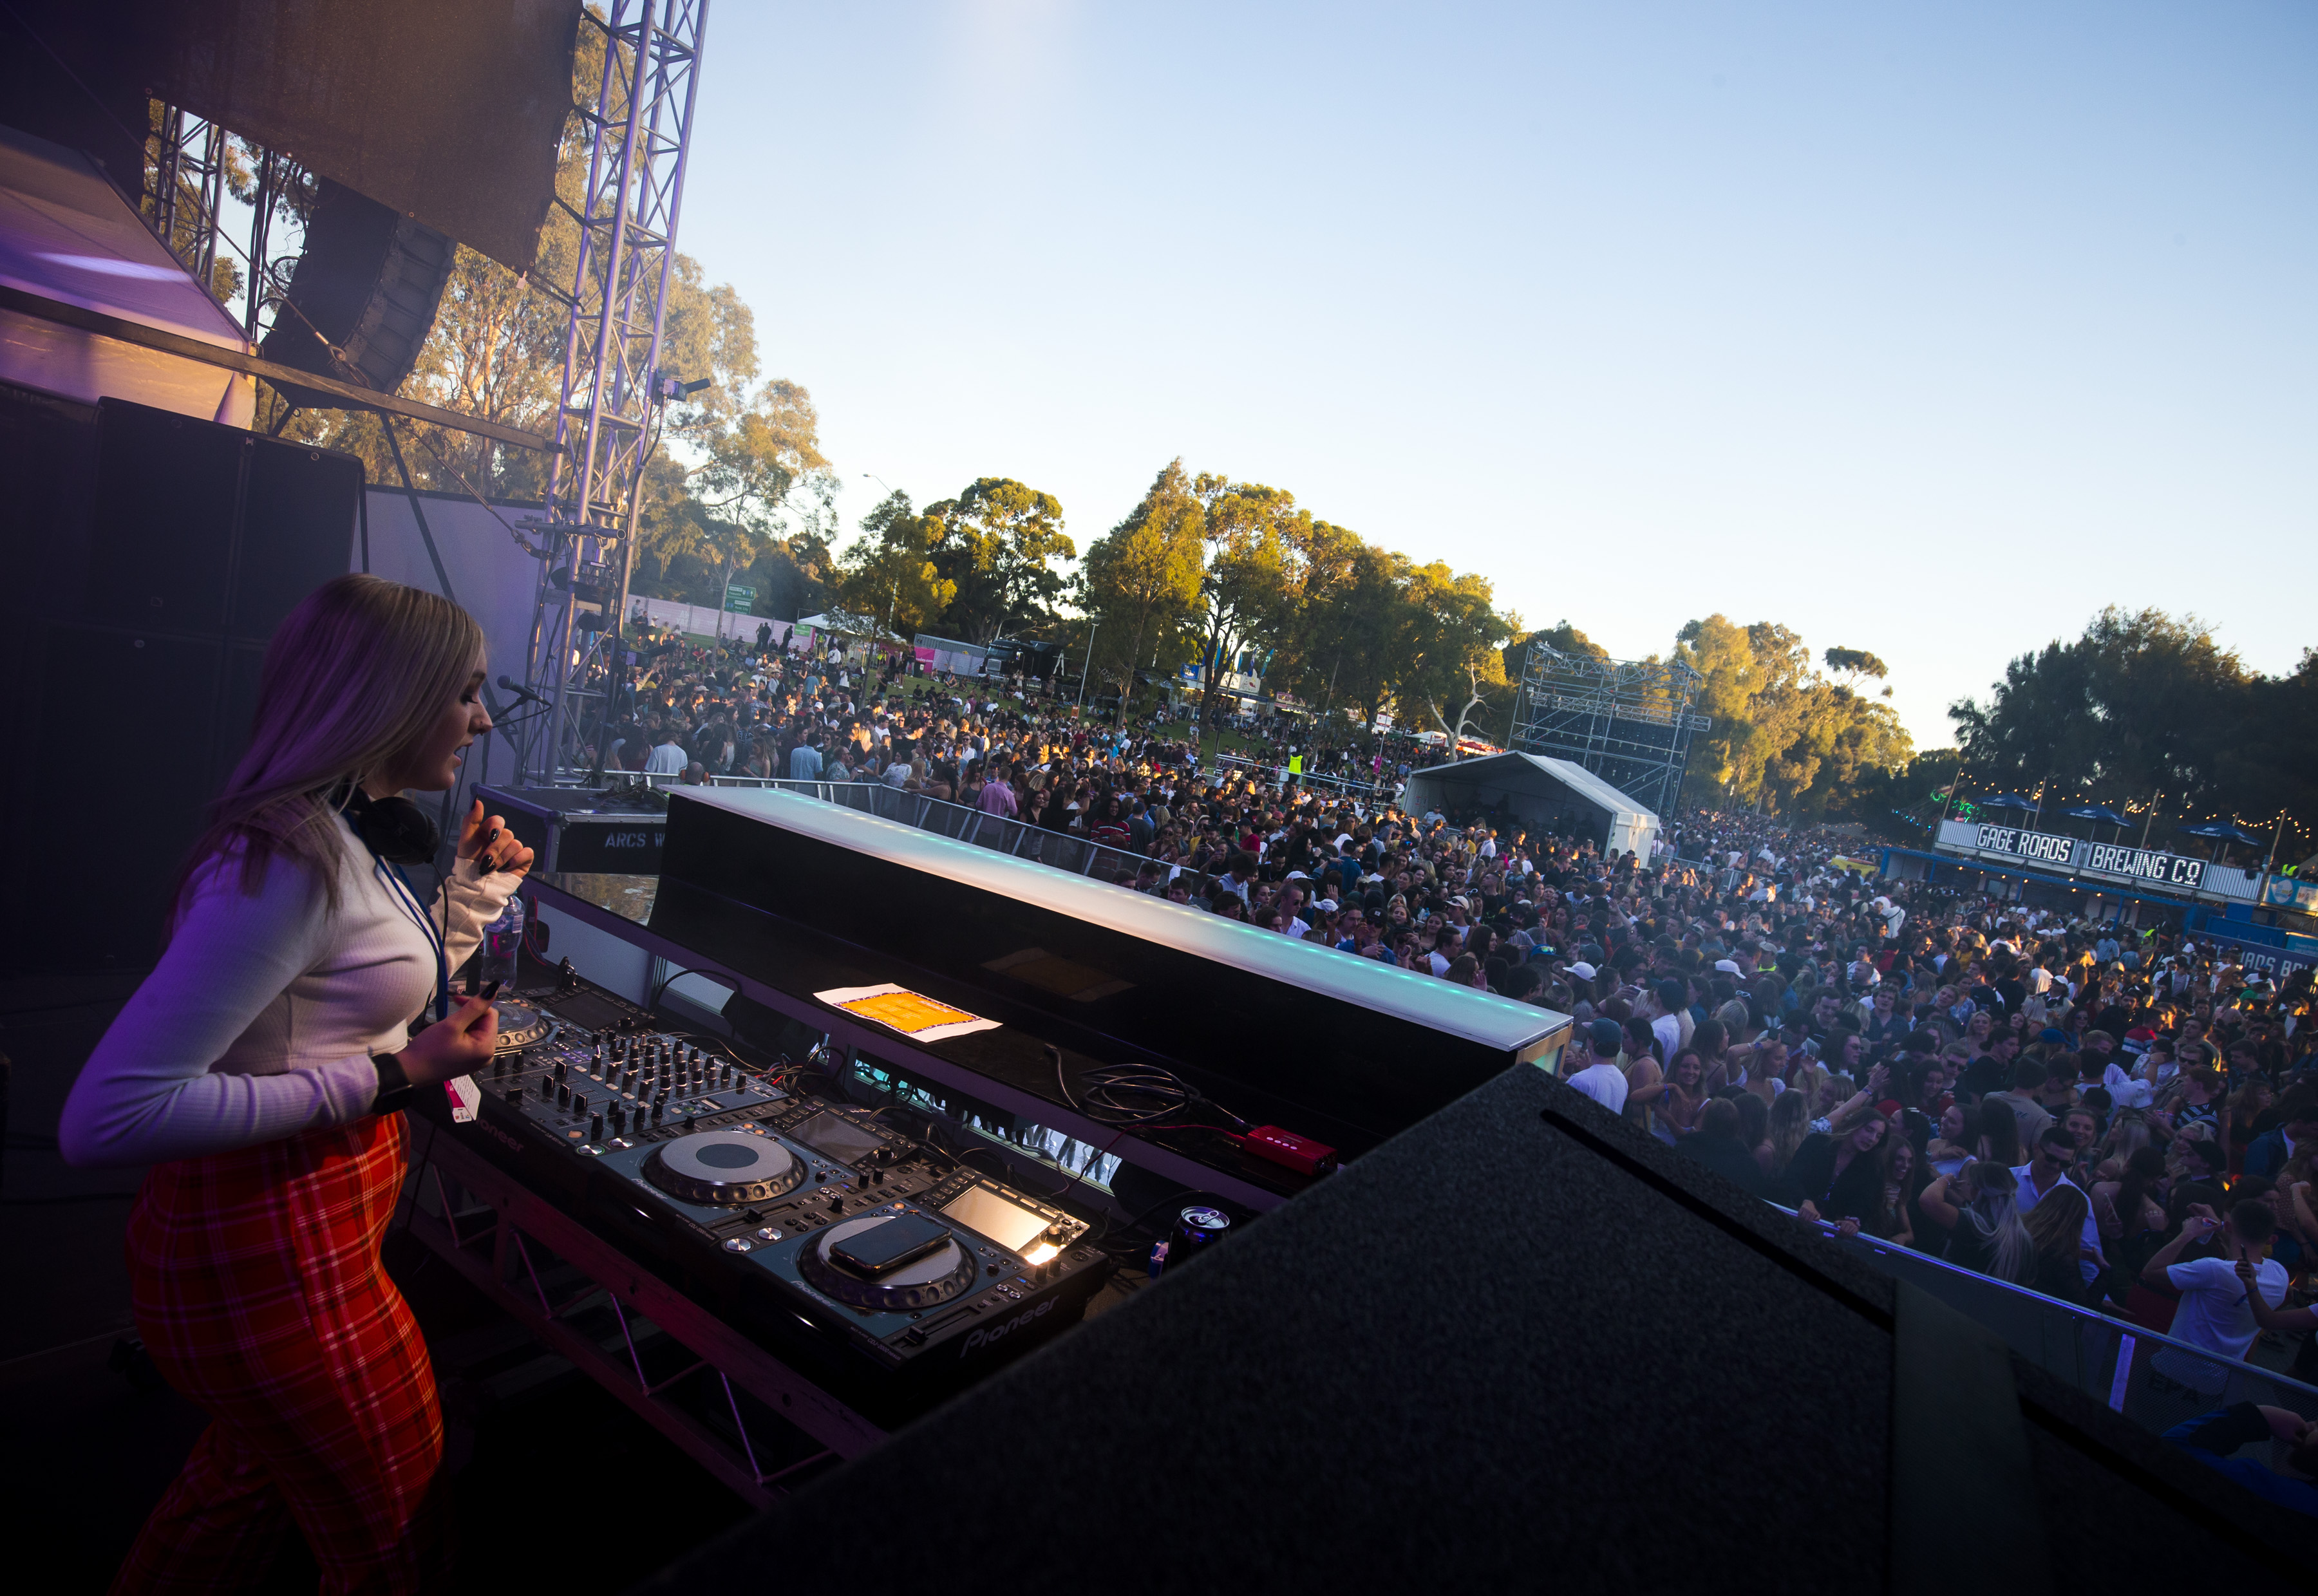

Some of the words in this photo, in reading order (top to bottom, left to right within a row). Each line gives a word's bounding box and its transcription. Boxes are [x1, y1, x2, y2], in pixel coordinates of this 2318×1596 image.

[605, 832, 646, 848] ARCS
[1977, 826, 2016, 852] GAGE
[2017, 832, 2071, 862] ROADS
[2091, 845, 2168, 879] BREWING
[475, 1116, 525, 1152] ioneer
[631, 1178, 668, 1200] Pioneer
[790, 1280, 836, 1308] Pioneer
[959, 1294, 1060, 1360] Pioneer
